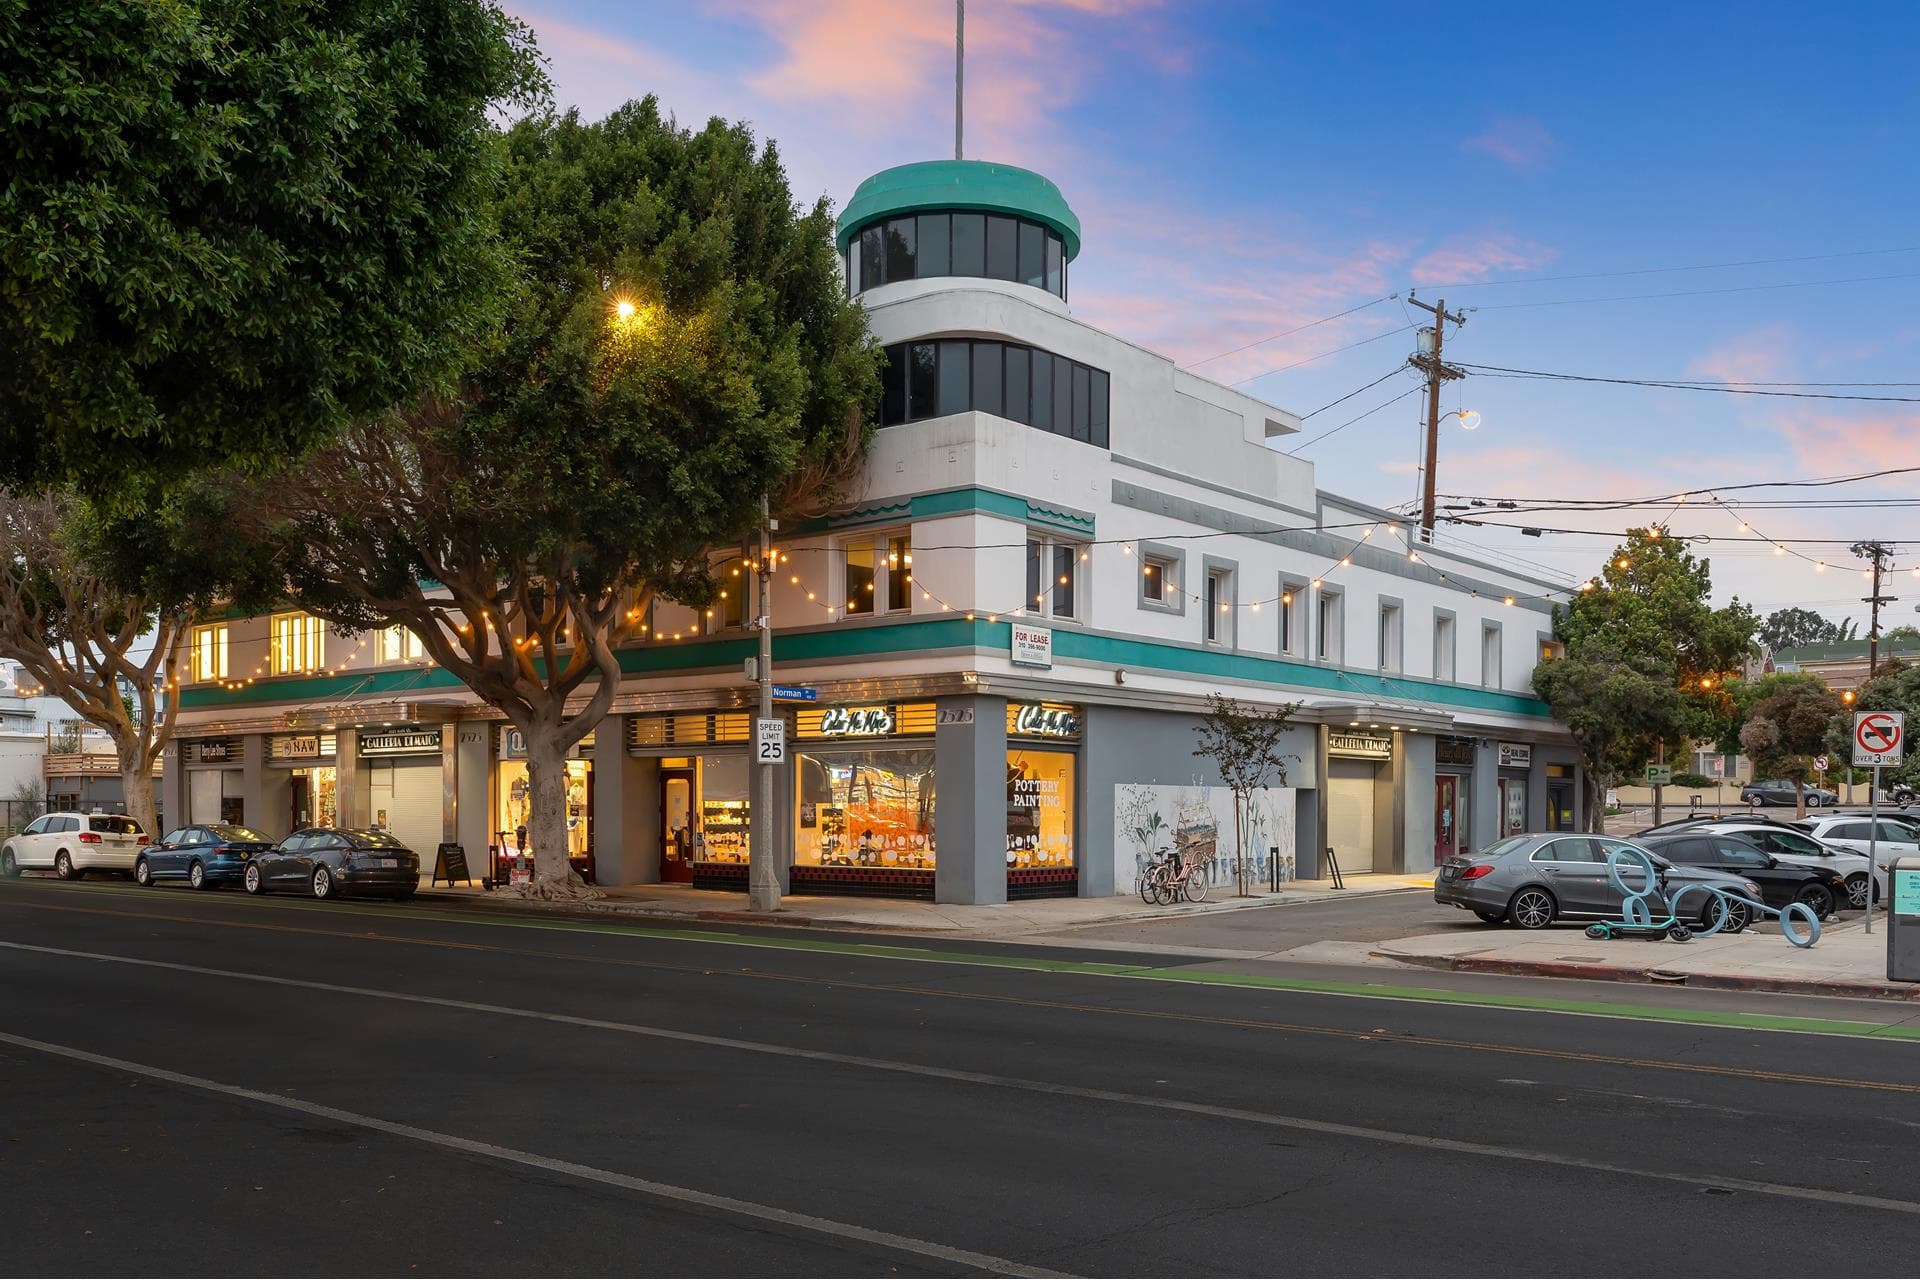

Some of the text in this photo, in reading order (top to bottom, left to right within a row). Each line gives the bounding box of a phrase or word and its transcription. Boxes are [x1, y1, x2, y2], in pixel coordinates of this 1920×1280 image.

[1015, 632, 1049, 645] FOR LEASE
[773, 687, 802, 698] Norman
[760, 723, 782, 731] SPEED
[293, 740, 316, 752] NAW
[366, 737, 402, 748] GALLERIA
[1332, 737, 1363, 750] GALLERIA
[761, 742, 781, 758] 25
[1874, 753, 1881, 763] 3
[1882, 755, 1900, 763] TONS
[1648, 767, 1659, 781] P
[1014, 779, 1060, 793] POTTERY
[1013, 794, 1061, 808] PAINTING
